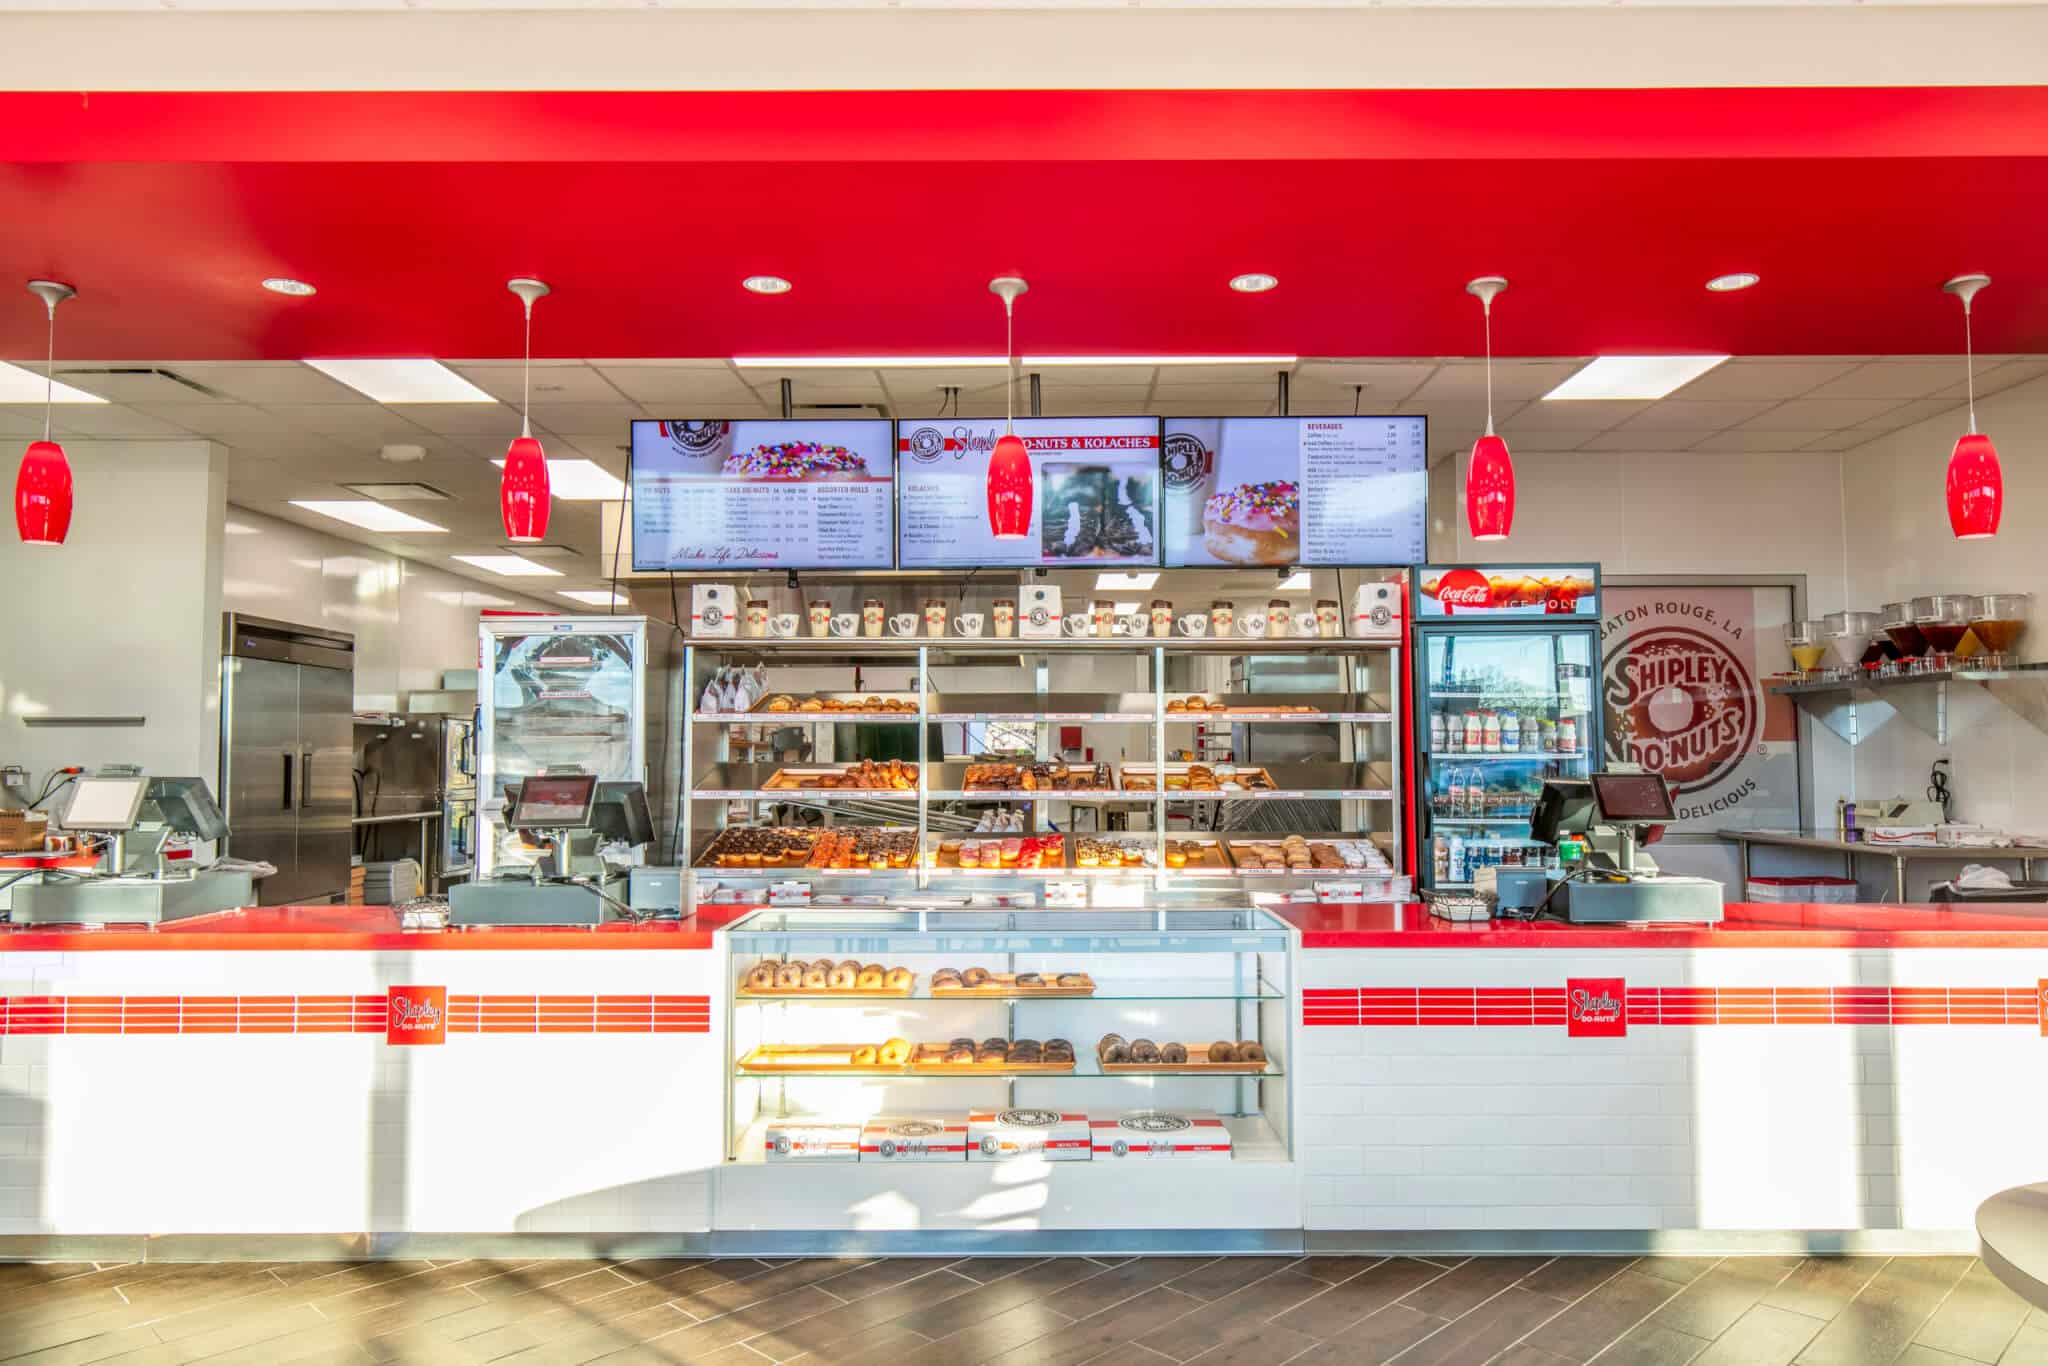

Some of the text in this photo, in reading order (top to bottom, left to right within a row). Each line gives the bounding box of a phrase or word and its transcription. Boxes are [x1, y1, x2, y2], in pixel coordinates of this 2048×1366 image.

[953, 426, 998, 460] Shipl
[1023, 438, 1150, 449] O-NUTS & KOLACHES
[1438, 586, 1488, 603] Coca-Cola
[1504, 600, 1578, 609] ICE COLD
[1655, 602, 1718, 626] ROUGE,
[1723, 619, 1744, 640] LA
[1607, 655, 1728, 706] SHIPLEY
[1679, 777, 1757, 819] DELICIOUS
[392, 995, 441, 1027] Shipley
[1571, 989, 1621, 1020] Shipley
